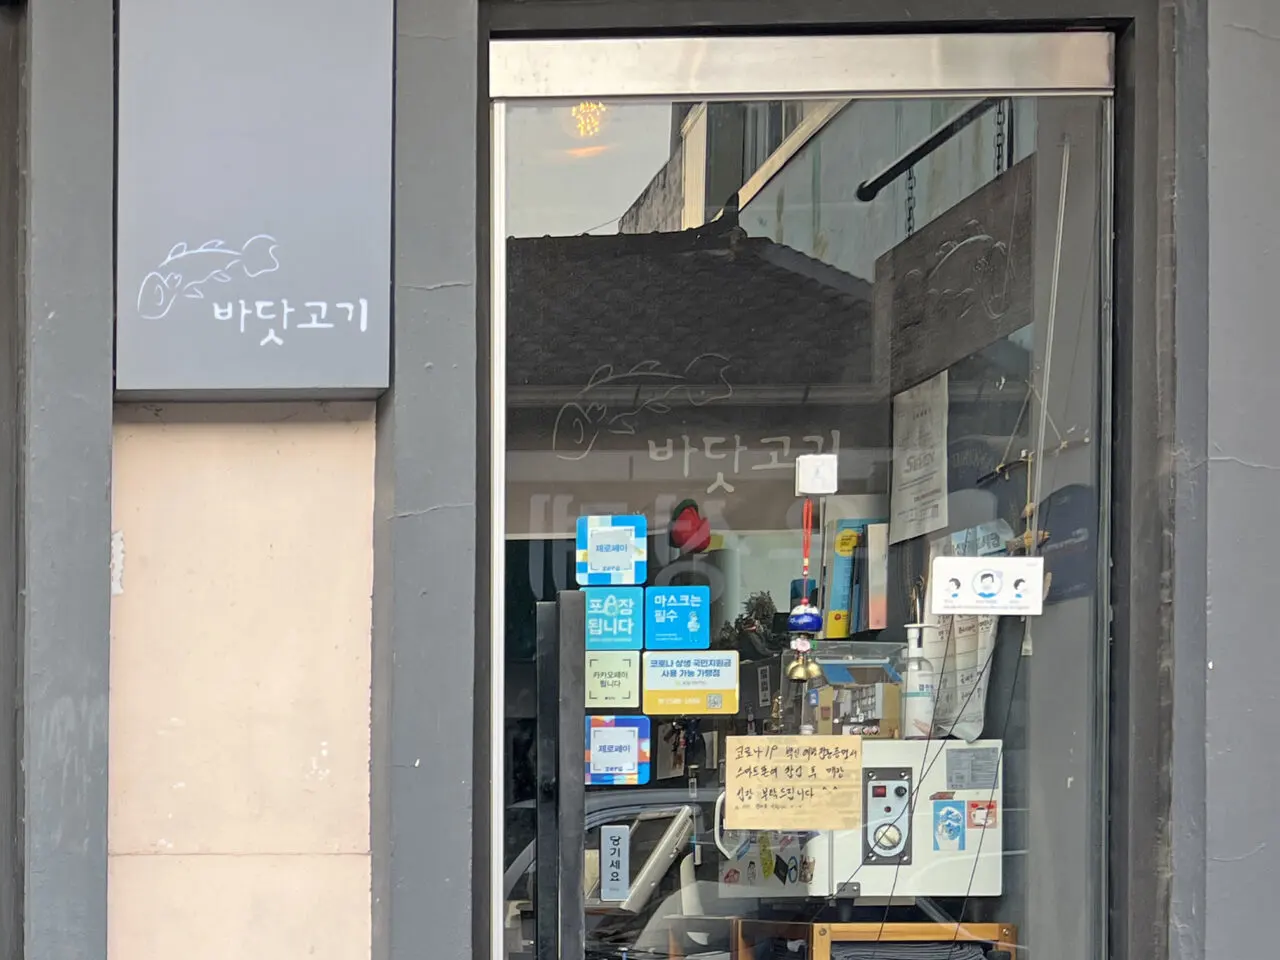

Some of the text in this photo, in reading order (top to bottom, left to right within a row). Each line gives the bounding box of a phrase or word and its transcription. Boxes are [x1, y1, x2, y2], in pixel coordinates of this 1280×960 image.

[213, 298, 369, 347] 바닷고기
[654, 595, 702, 607] 마스크는
[654, 610, 678, 623] 필수
[588, 618, 634, 635] 됩니다
[650, 659, 674, 668] 코로나
[693, 658, 732, 668] 국민지원금
[593, 671, 628, 679] 카카오페이
[661, 669, 721, 678] 사용 가능 가맹점
[600, 679, 621, 688] 됩니다
[598, 744, 631, 753] 제로페이
[609, 835, 622, 882] 당기세요
